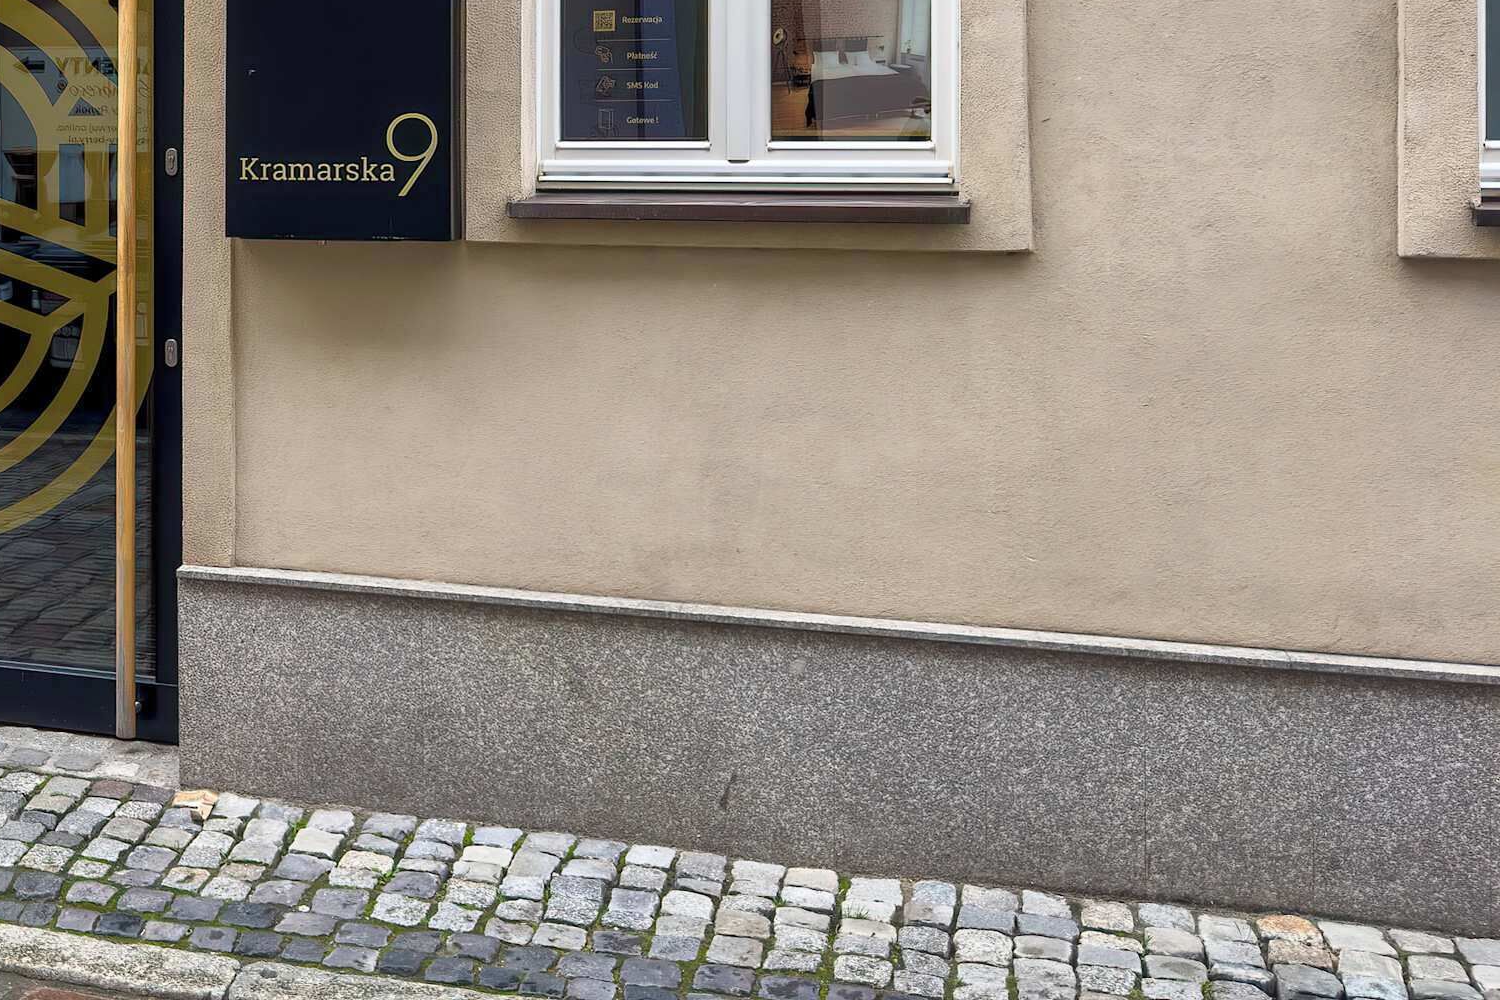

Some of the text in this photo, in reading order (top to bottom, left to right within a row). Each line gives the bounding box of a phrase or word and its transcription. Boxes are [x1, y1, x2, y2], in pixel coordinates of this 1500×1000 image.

[621, 15, 663, 25] Rezerwacja
[626, 51, 658, 60] Płatność
[626, 81, 659, 89] SMS Kod
[239, 112, 438, 197] Kramarska 9
